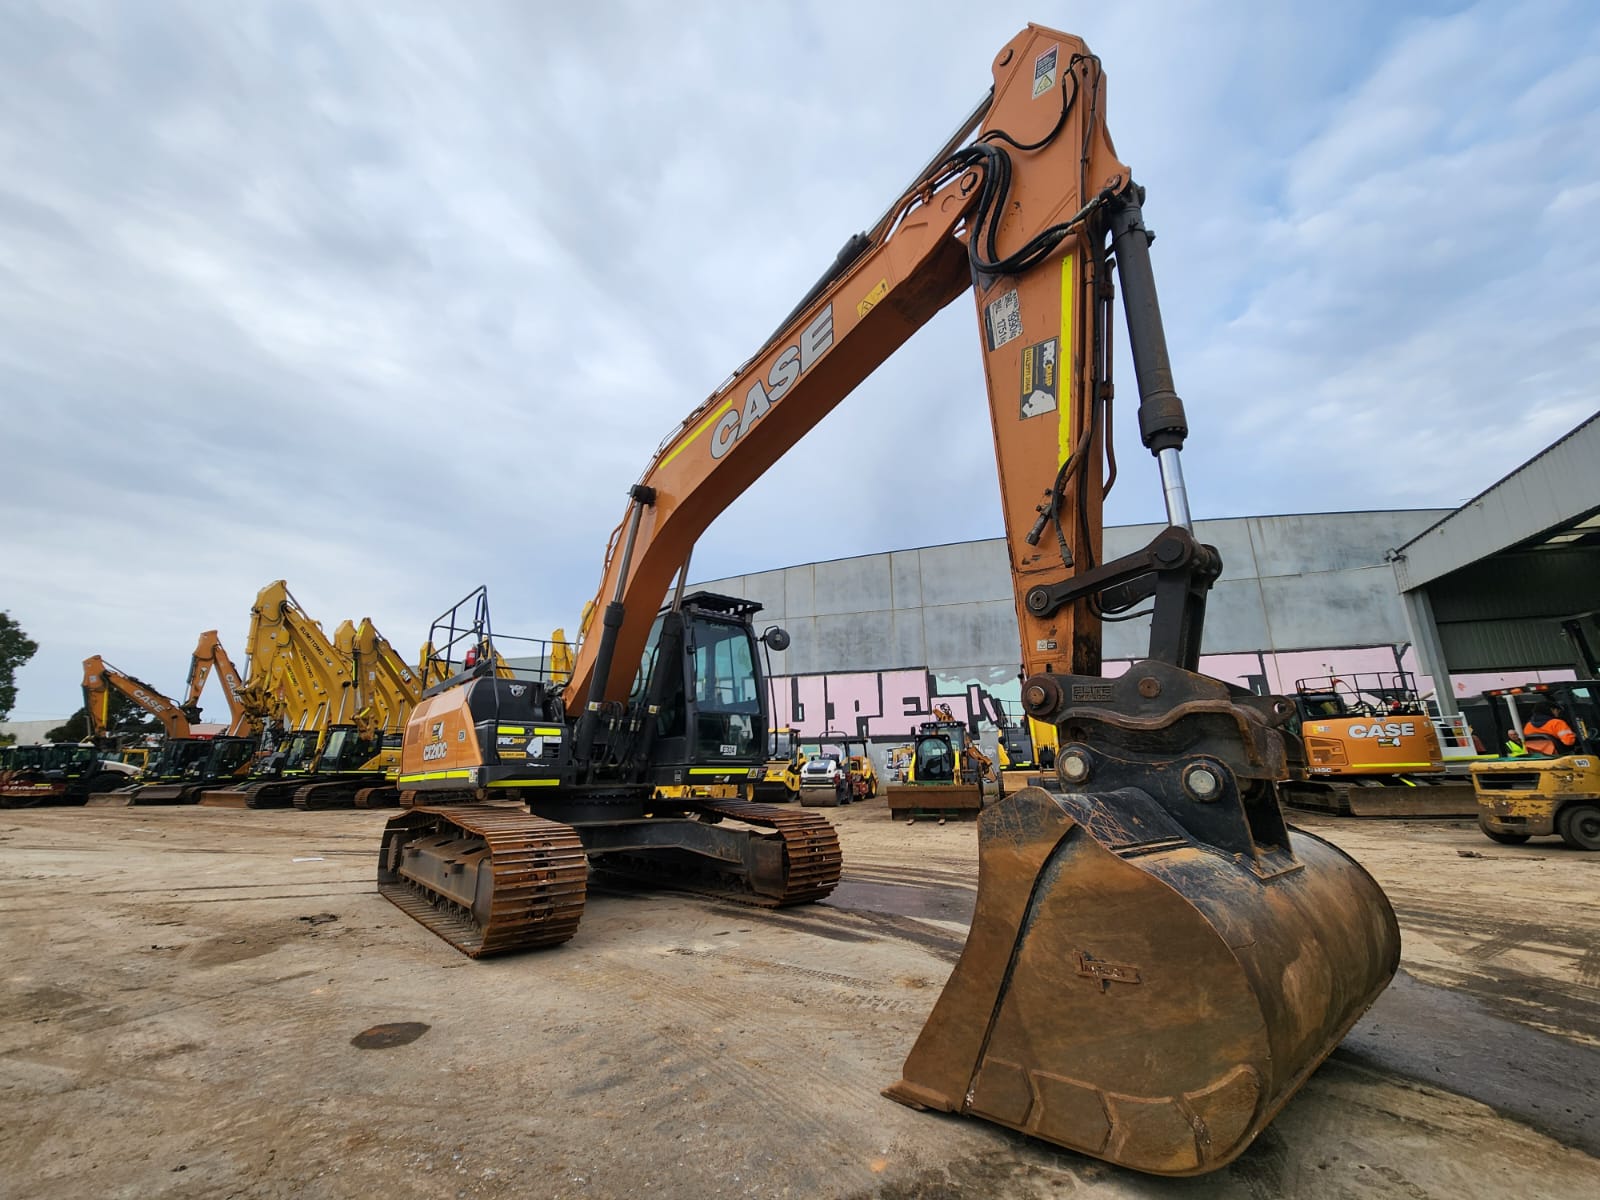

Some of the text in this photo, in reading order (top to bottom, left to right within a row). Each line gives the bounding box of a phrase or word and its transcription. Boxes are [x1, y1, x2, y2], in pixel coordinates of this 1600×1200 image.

[711, 302, 834, 459] CASE
[300, 626, 324, 656] SUMITOMO
[133, 689, 165, 713] CASE
[1348, 722, 1415, 738] CASE
